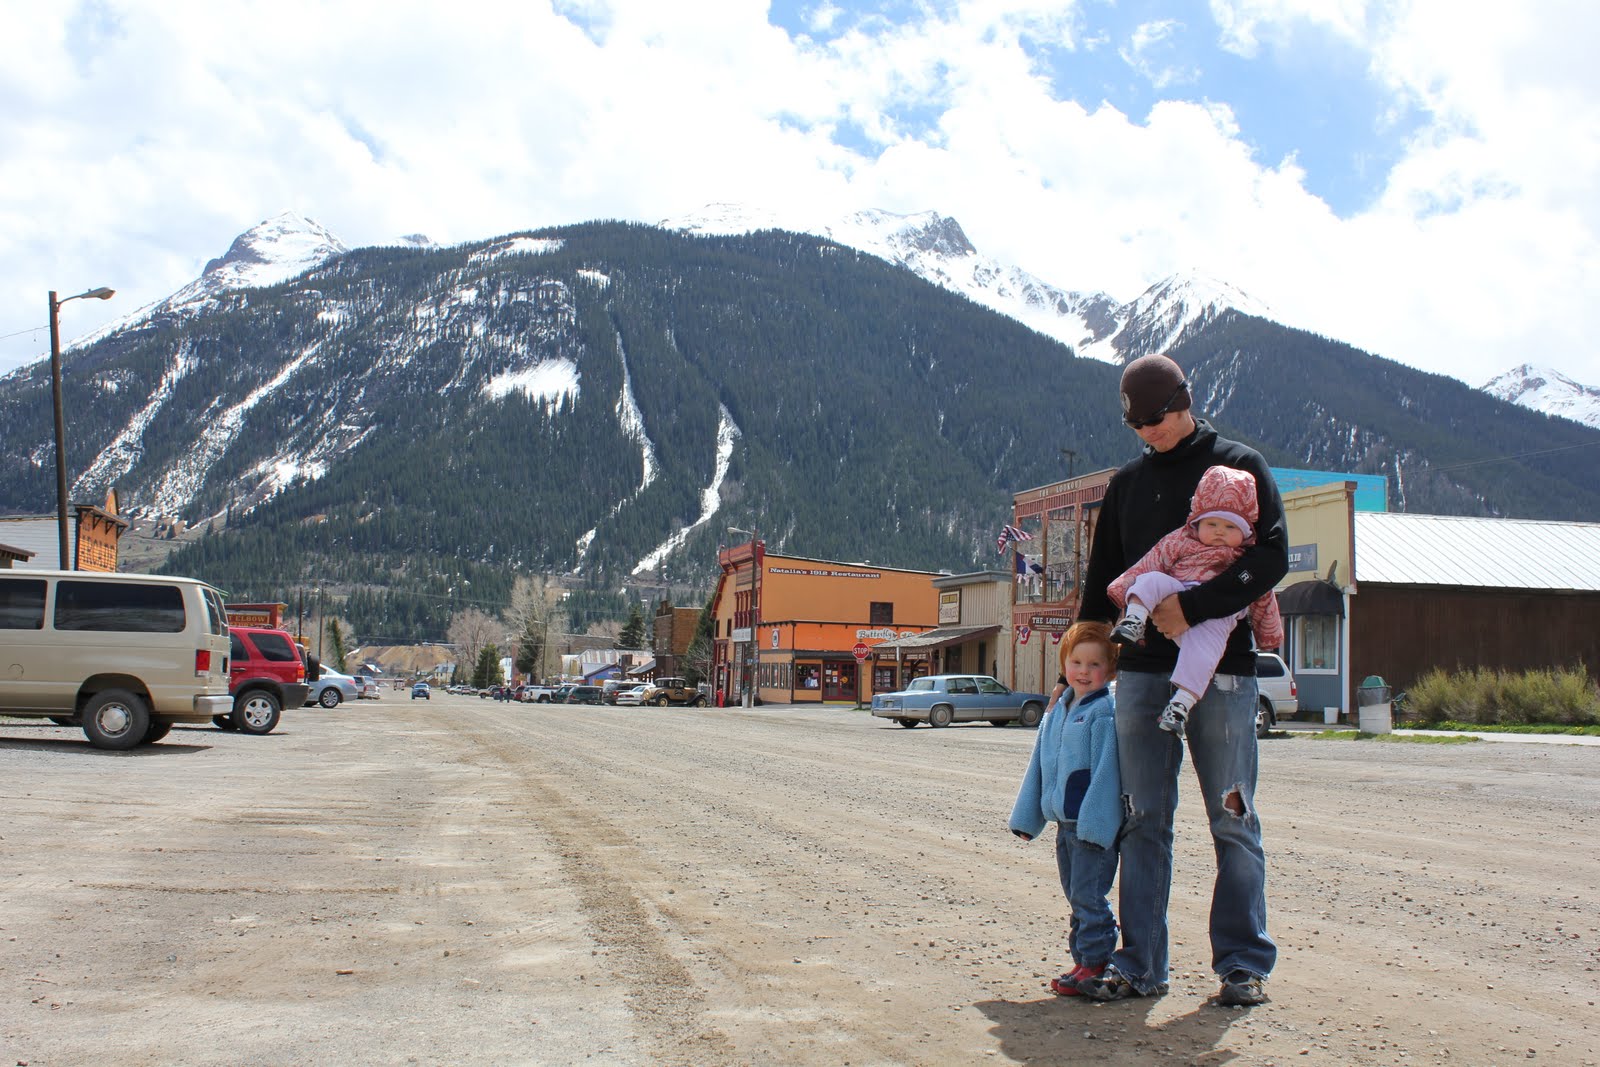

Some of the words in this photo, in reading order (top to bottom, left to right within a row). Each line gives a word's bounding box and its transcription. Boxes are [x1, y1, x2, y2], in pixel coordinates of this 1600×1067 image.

[1040, 488, 1049, 497] THE
[1056, 480, 1082, 493] LOOKOUT
[770, 567, 807, 575] Natalia's
[1046, 617, 1070, 625] LOOKOUT
[859, 629, 891, 640] Butterfly
